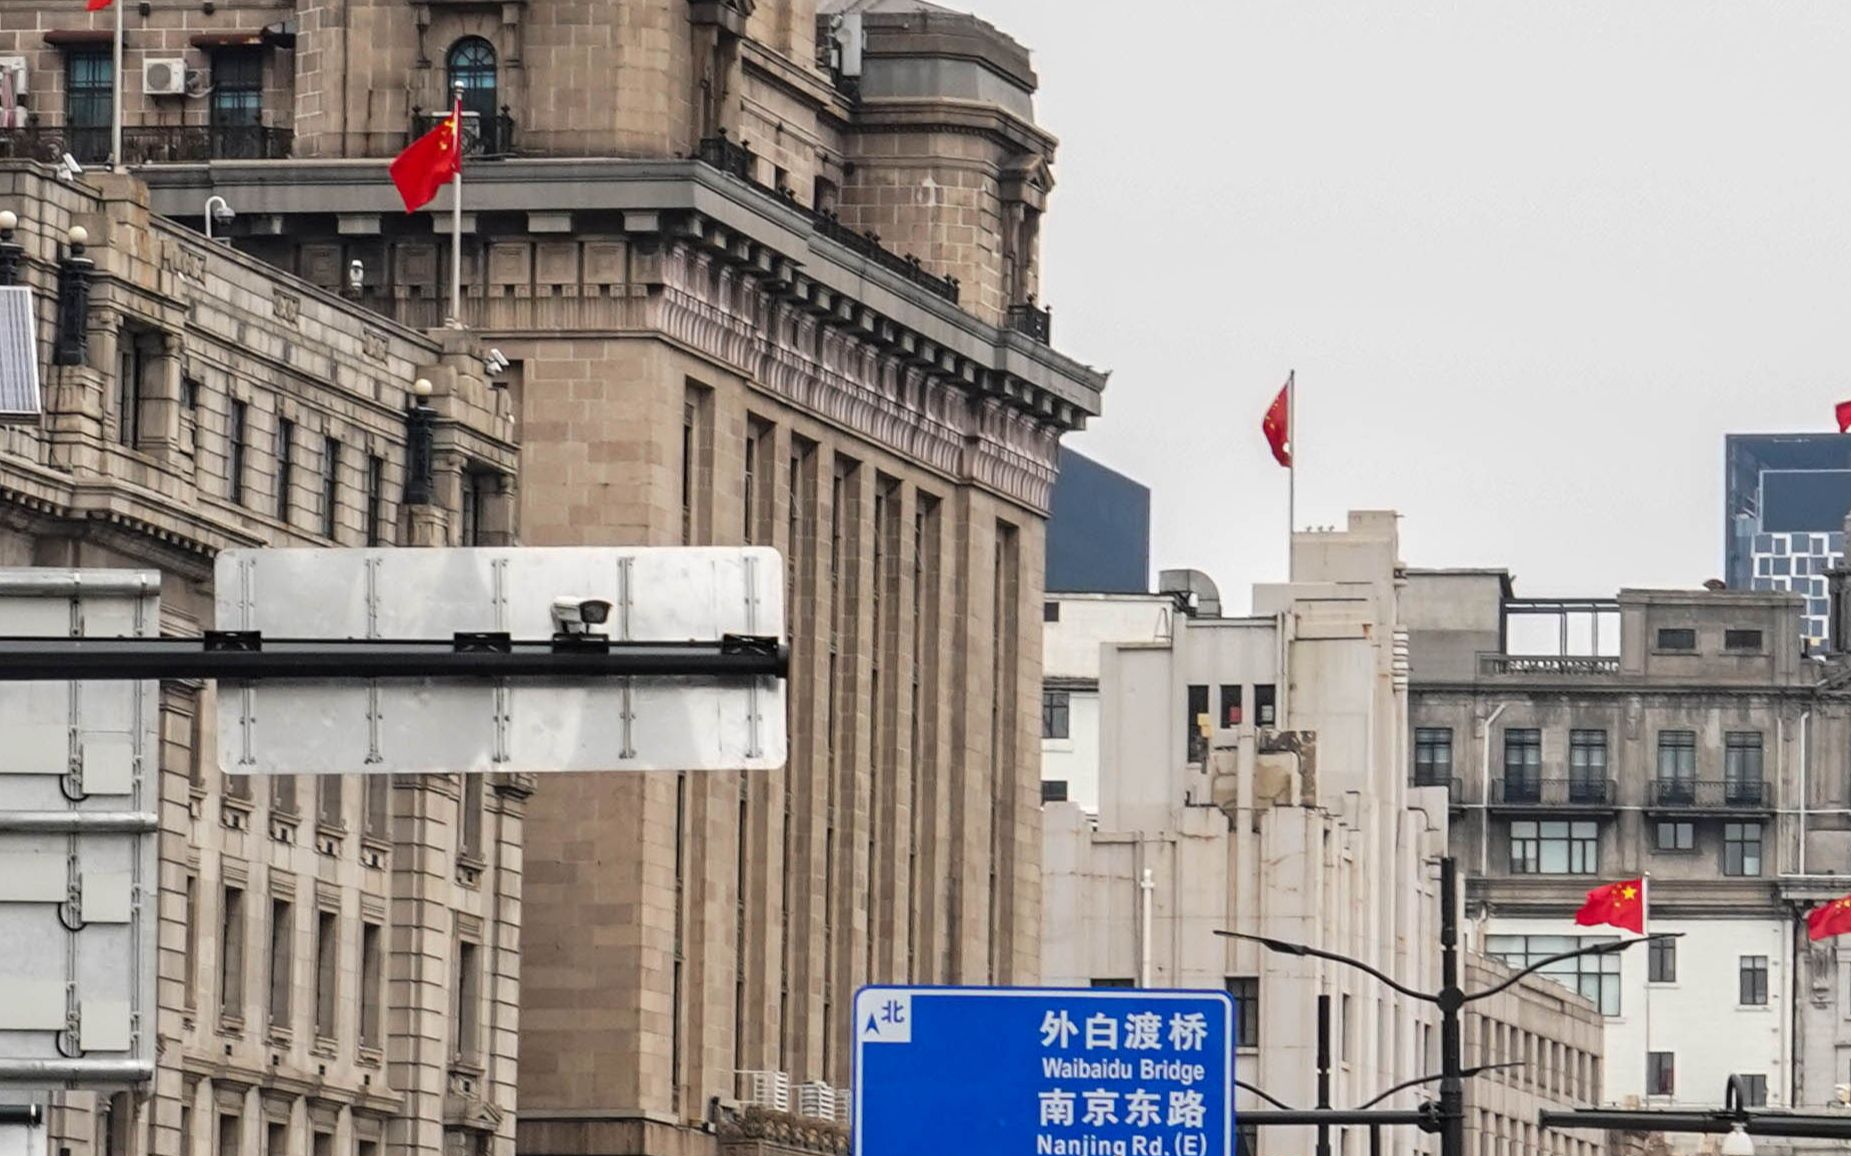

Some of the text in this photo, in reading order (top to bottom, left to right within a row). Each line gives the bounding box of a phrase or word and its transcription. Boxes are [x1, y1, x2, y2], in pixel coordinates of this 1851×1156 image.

[881, 999, 905, 1024] 北
[1039, 1009, 1208, 1051] 外白渡桥
[1042, 1056, 1205, 1086] Waibaidu Bridge
[1037, 1088, 1207, 1129] 南京东路
